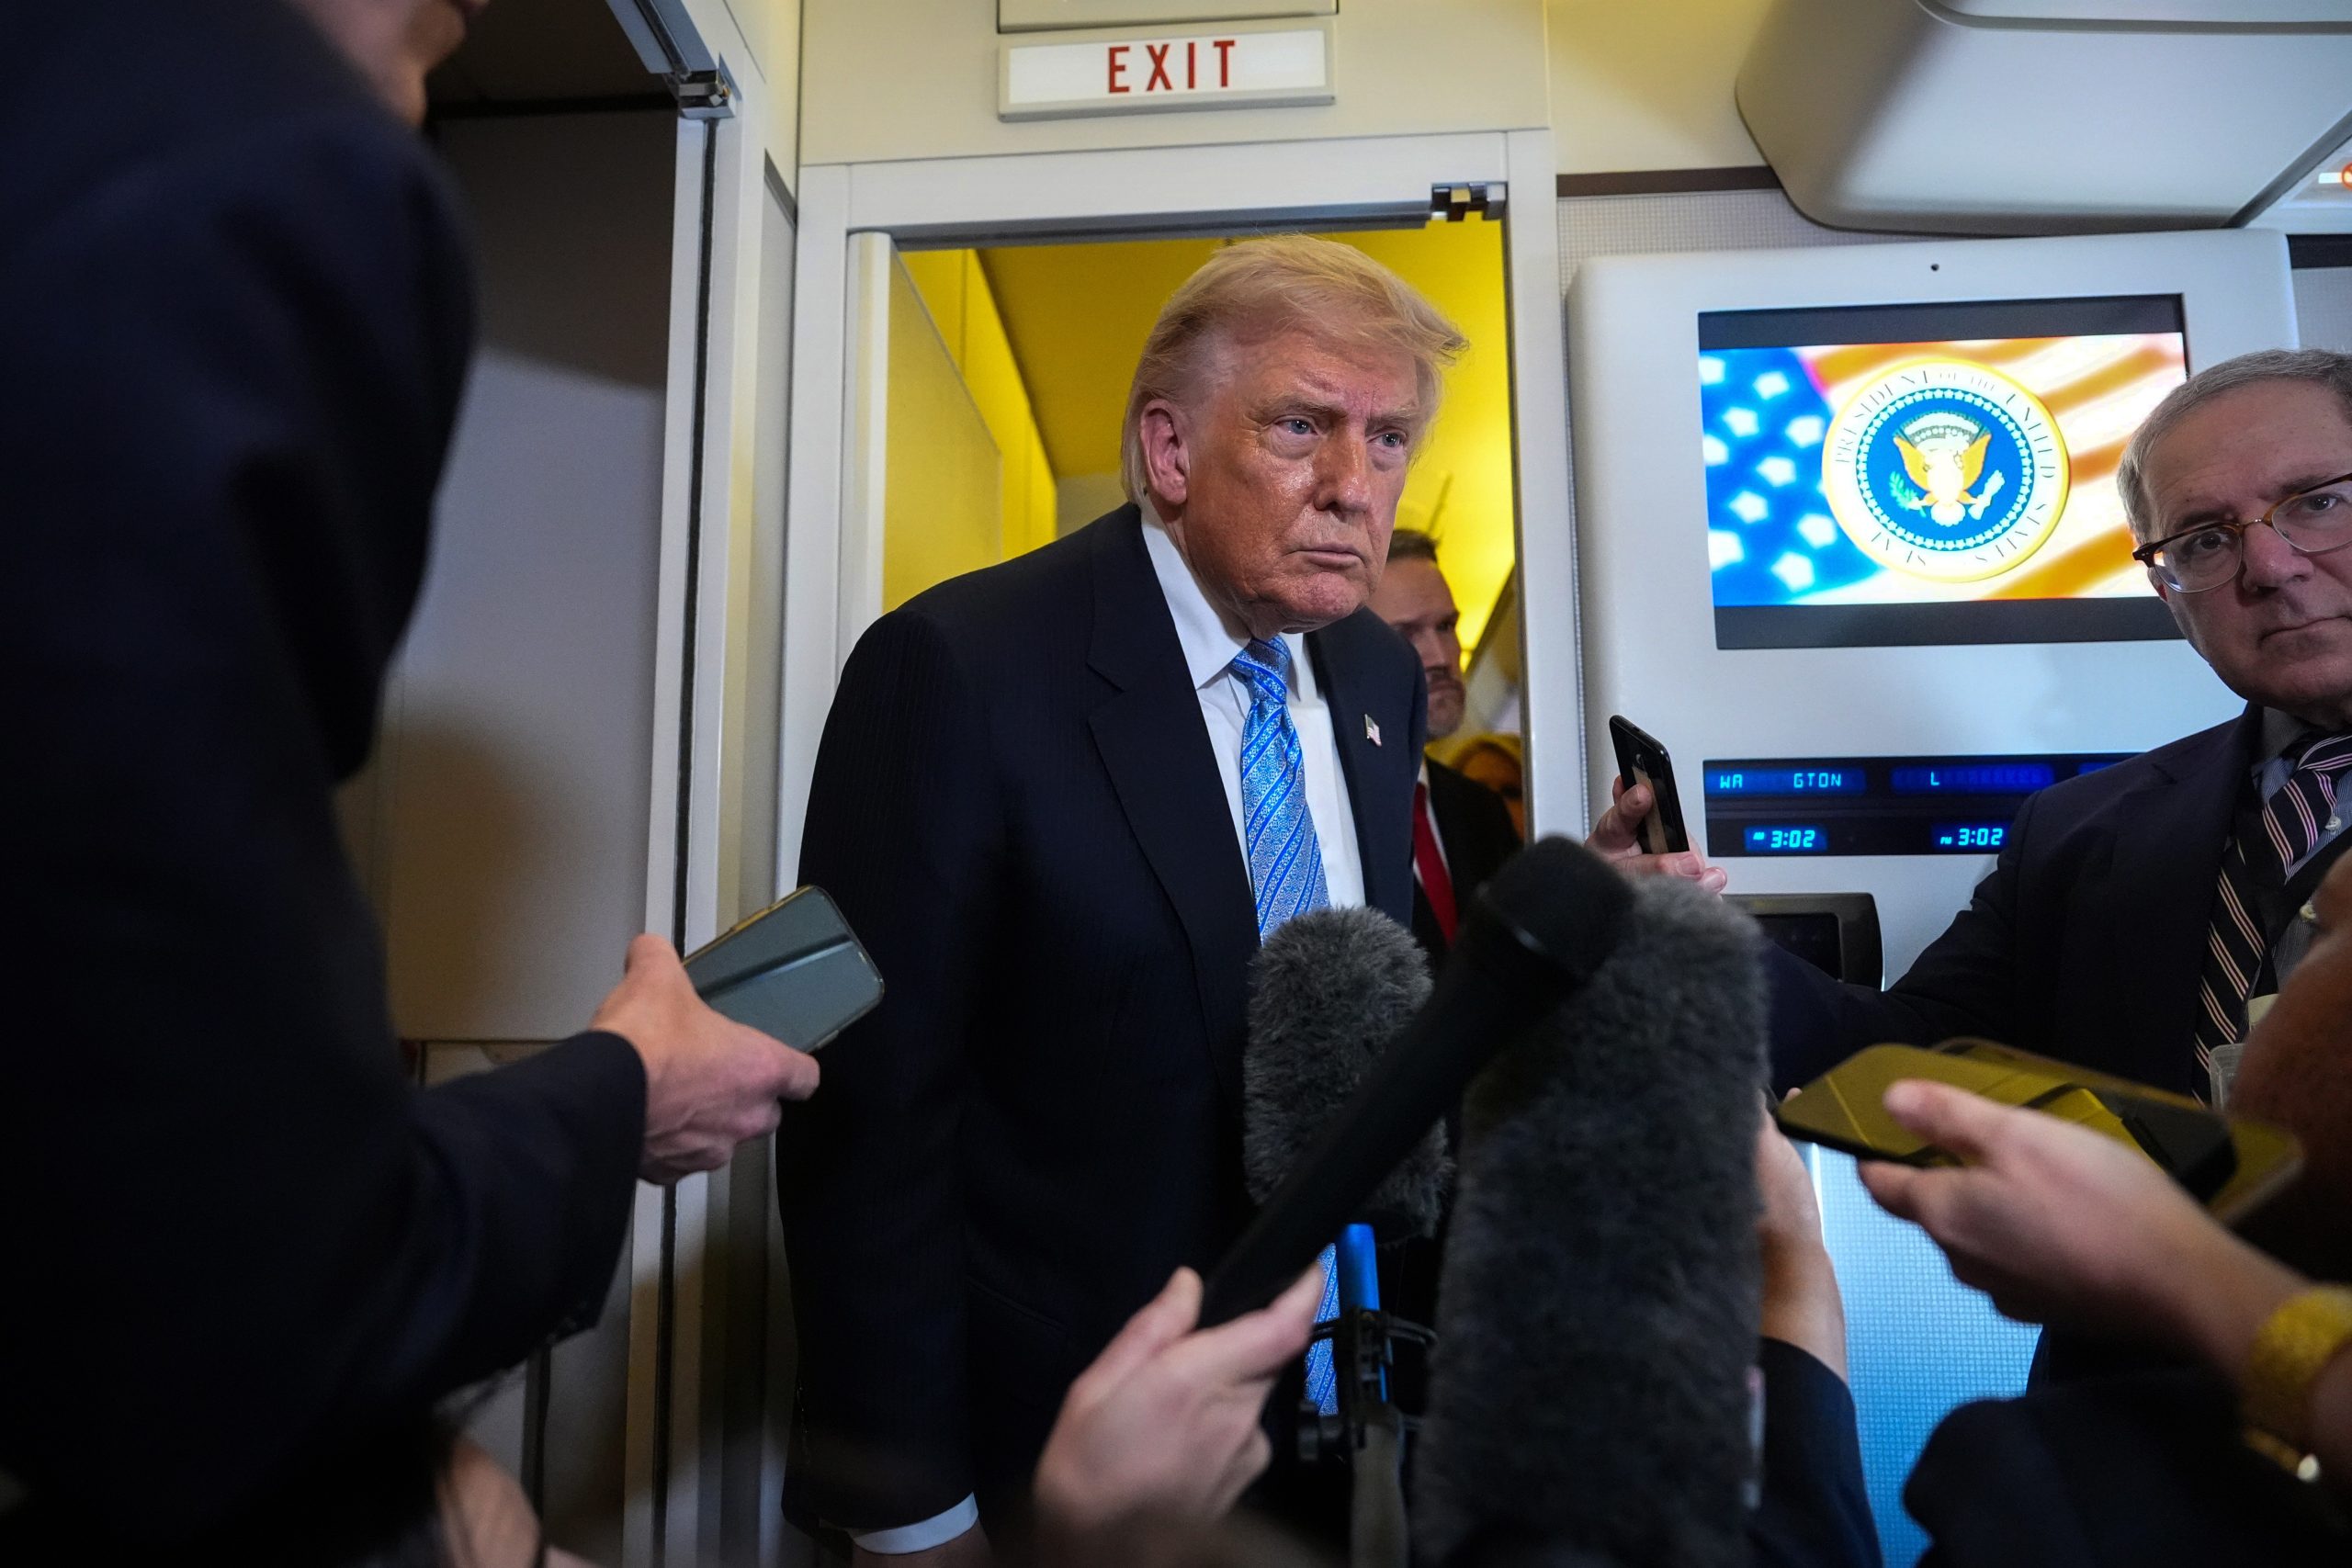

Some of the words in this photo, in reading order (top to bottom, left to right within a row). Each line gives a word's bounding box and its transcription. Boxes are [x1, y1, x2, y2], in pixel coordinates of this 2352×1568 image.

[1108, 40, 1236, 94] EXIT
[1770, 830, 1815, 848] 3:02
[1958, 829, 2003, 845] 3:02
